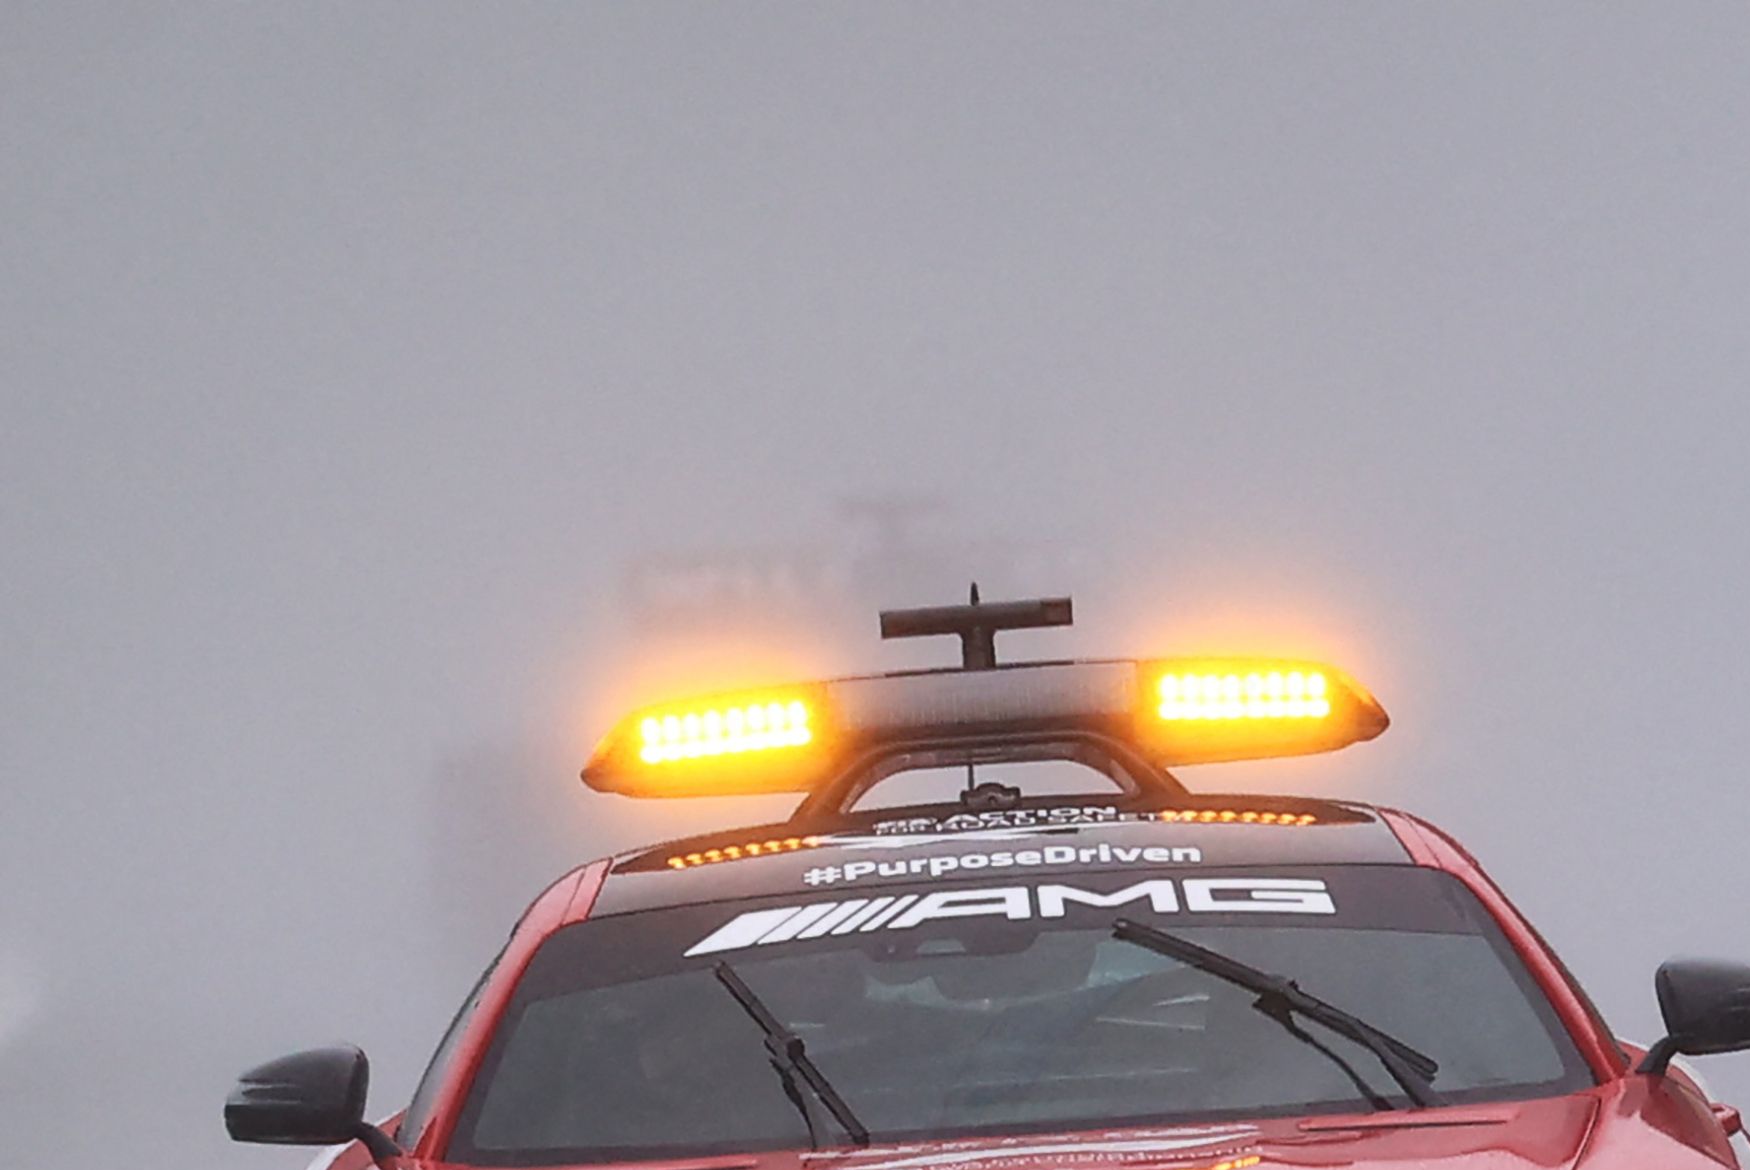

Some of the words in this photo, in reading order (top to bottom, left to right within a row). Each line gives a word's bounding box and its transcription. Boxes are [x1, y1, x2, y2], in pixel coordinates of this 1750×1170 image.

[944, 806, 1116, 828] ACTION
[804, 841, 1200, 886] #PurposeDriven
[889, 878, 1336, 928] AMG
